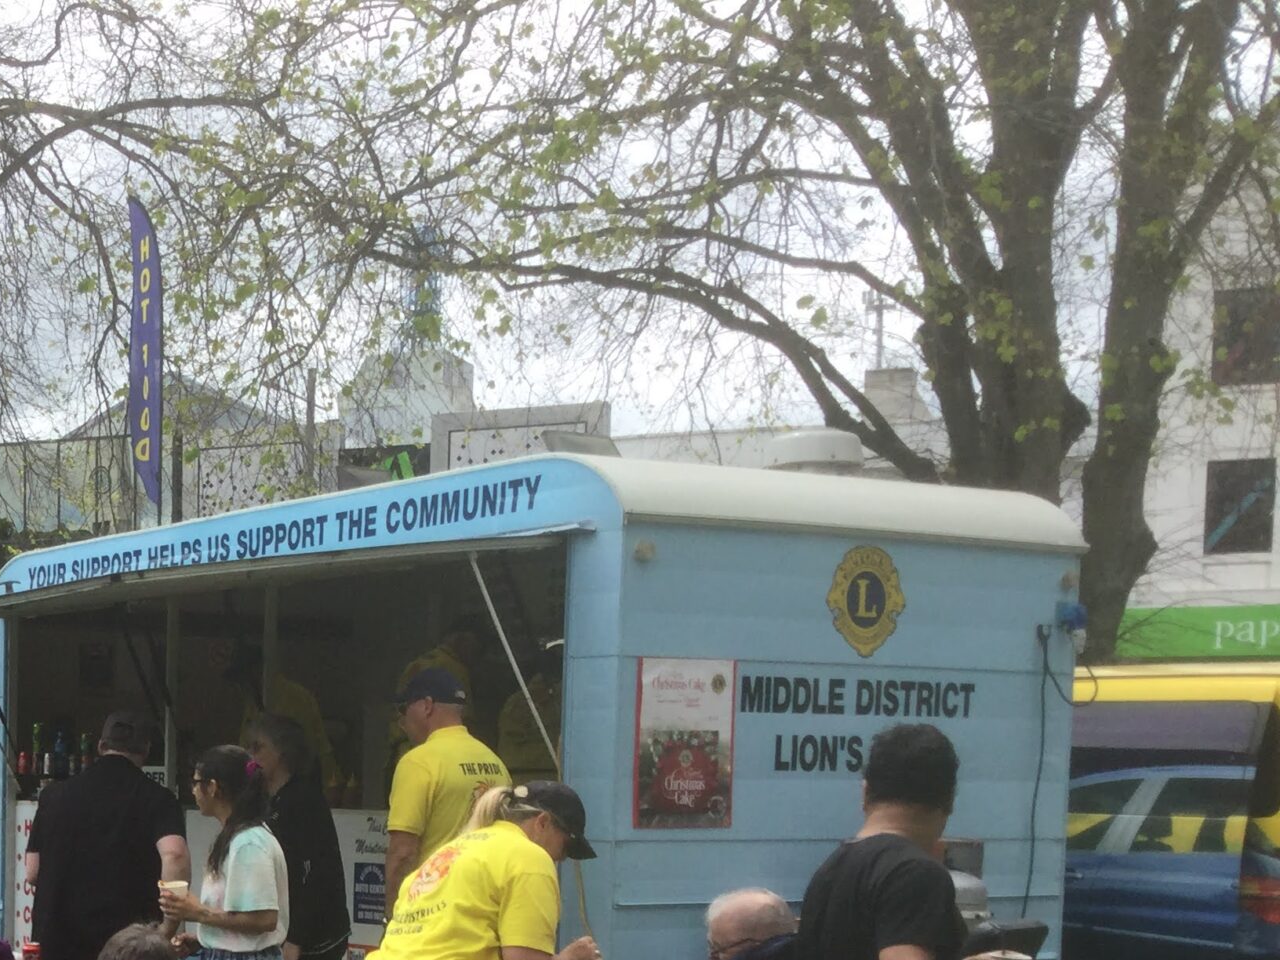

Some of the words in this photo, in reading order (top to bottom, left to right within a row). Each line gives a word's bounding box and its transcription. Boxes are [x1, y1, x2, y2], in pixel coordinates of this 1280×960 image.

[28, 561, 67, 590] YOUR
[71, 549, 143, 583] SUPPORT
[147, 538, 203, 576] HELPS
[207, 535, 231, 562] US
[236, 516, 329, 561] SUPPORT
[335, 505, 379, 542] THE
[385, 474, 543, 535] COMMUNITY
[740, 676, 846, 716] MIDDLE
[855, 680, 976, 719] DISTRICT
[459, 763, 477, 776] THE
[774, 734, 863, 773] LION'S
